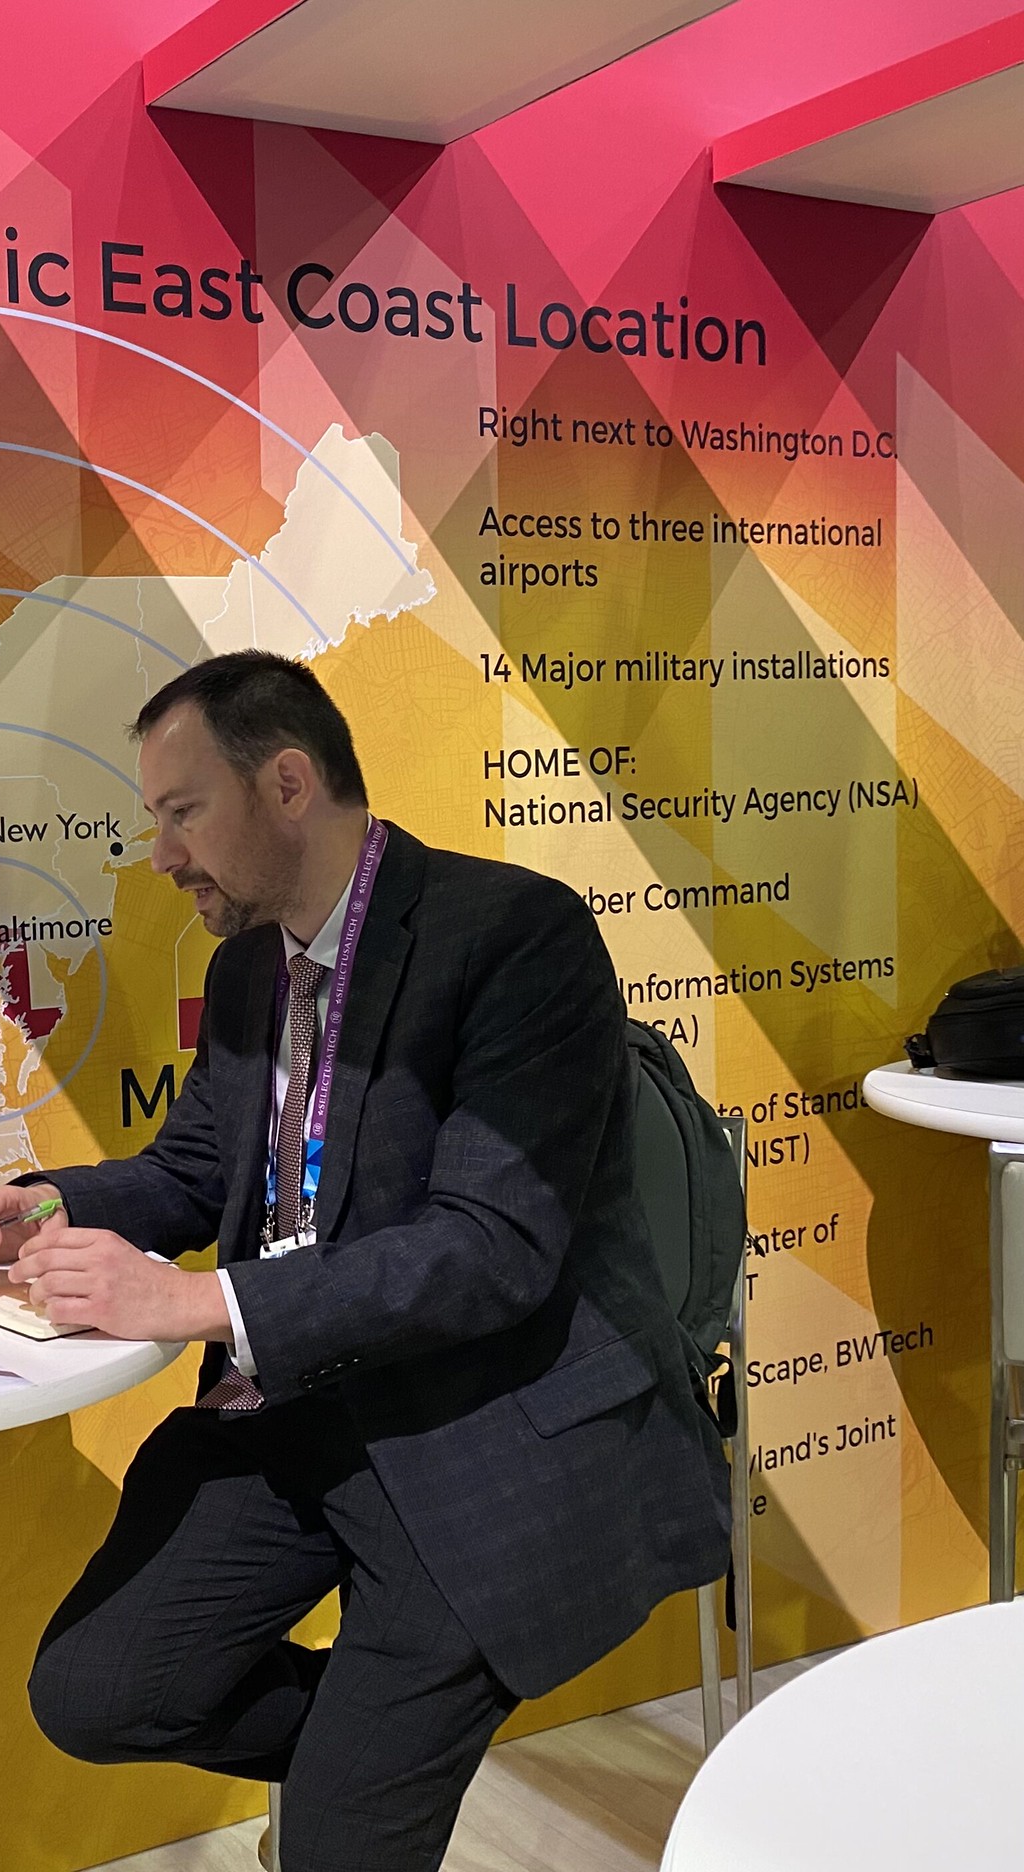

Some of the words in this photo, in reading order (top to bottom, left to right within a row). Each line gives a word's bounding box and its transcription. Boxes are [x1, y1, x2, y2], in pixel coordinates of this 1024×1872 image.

[101, 241, 264, 323] East
[286, 262, 482, 343] Coast
[506, 282, 768, 366] Location
[479, 406, 562, 449] Right
[572, 417, 636, 446] next
[645, 420, 674, 448] to
[680, 420, 843, 461] Washington
[853, 430, 899, 460] D.C.
[479, 507, 582, 540] Access
[591, 512, 621, 541] to
[630, 510, 704, 543] three
[713, 512, 883, 547] international
[479, 556, 599, 594] airports
[480, 653, 512, 683] 14
[521, 651, 606, 690] Major
[615, 653, 724, 688] military
[732, 651, 890, 682] installations
[483, 748, 579, 780] HOME
[589, 746, 636, 775] OF:
[484, 789, 612, 828] National
[622, 786, 736, 824] Security
[743, 784, 841, 820] Agency
[849, 778, 919, 813] (NSA)
[56, 812, 123, 841] York
[582, 886, 636, 916] ber
[643, 872, 790, 913] Command
[618, 964, 782, 1005] Information
[790, 954, 894, 993] Systems
[752, 1093, 779, 1124] of
[747, 1132, 810, 1168] NIST)
[813, 1213, 839, 1243] of
[747, 1352, 829, 1387] Scape,
[836, 1322, 934, 1368] BWTech
[836, 1414, 896, 1452] Joint
